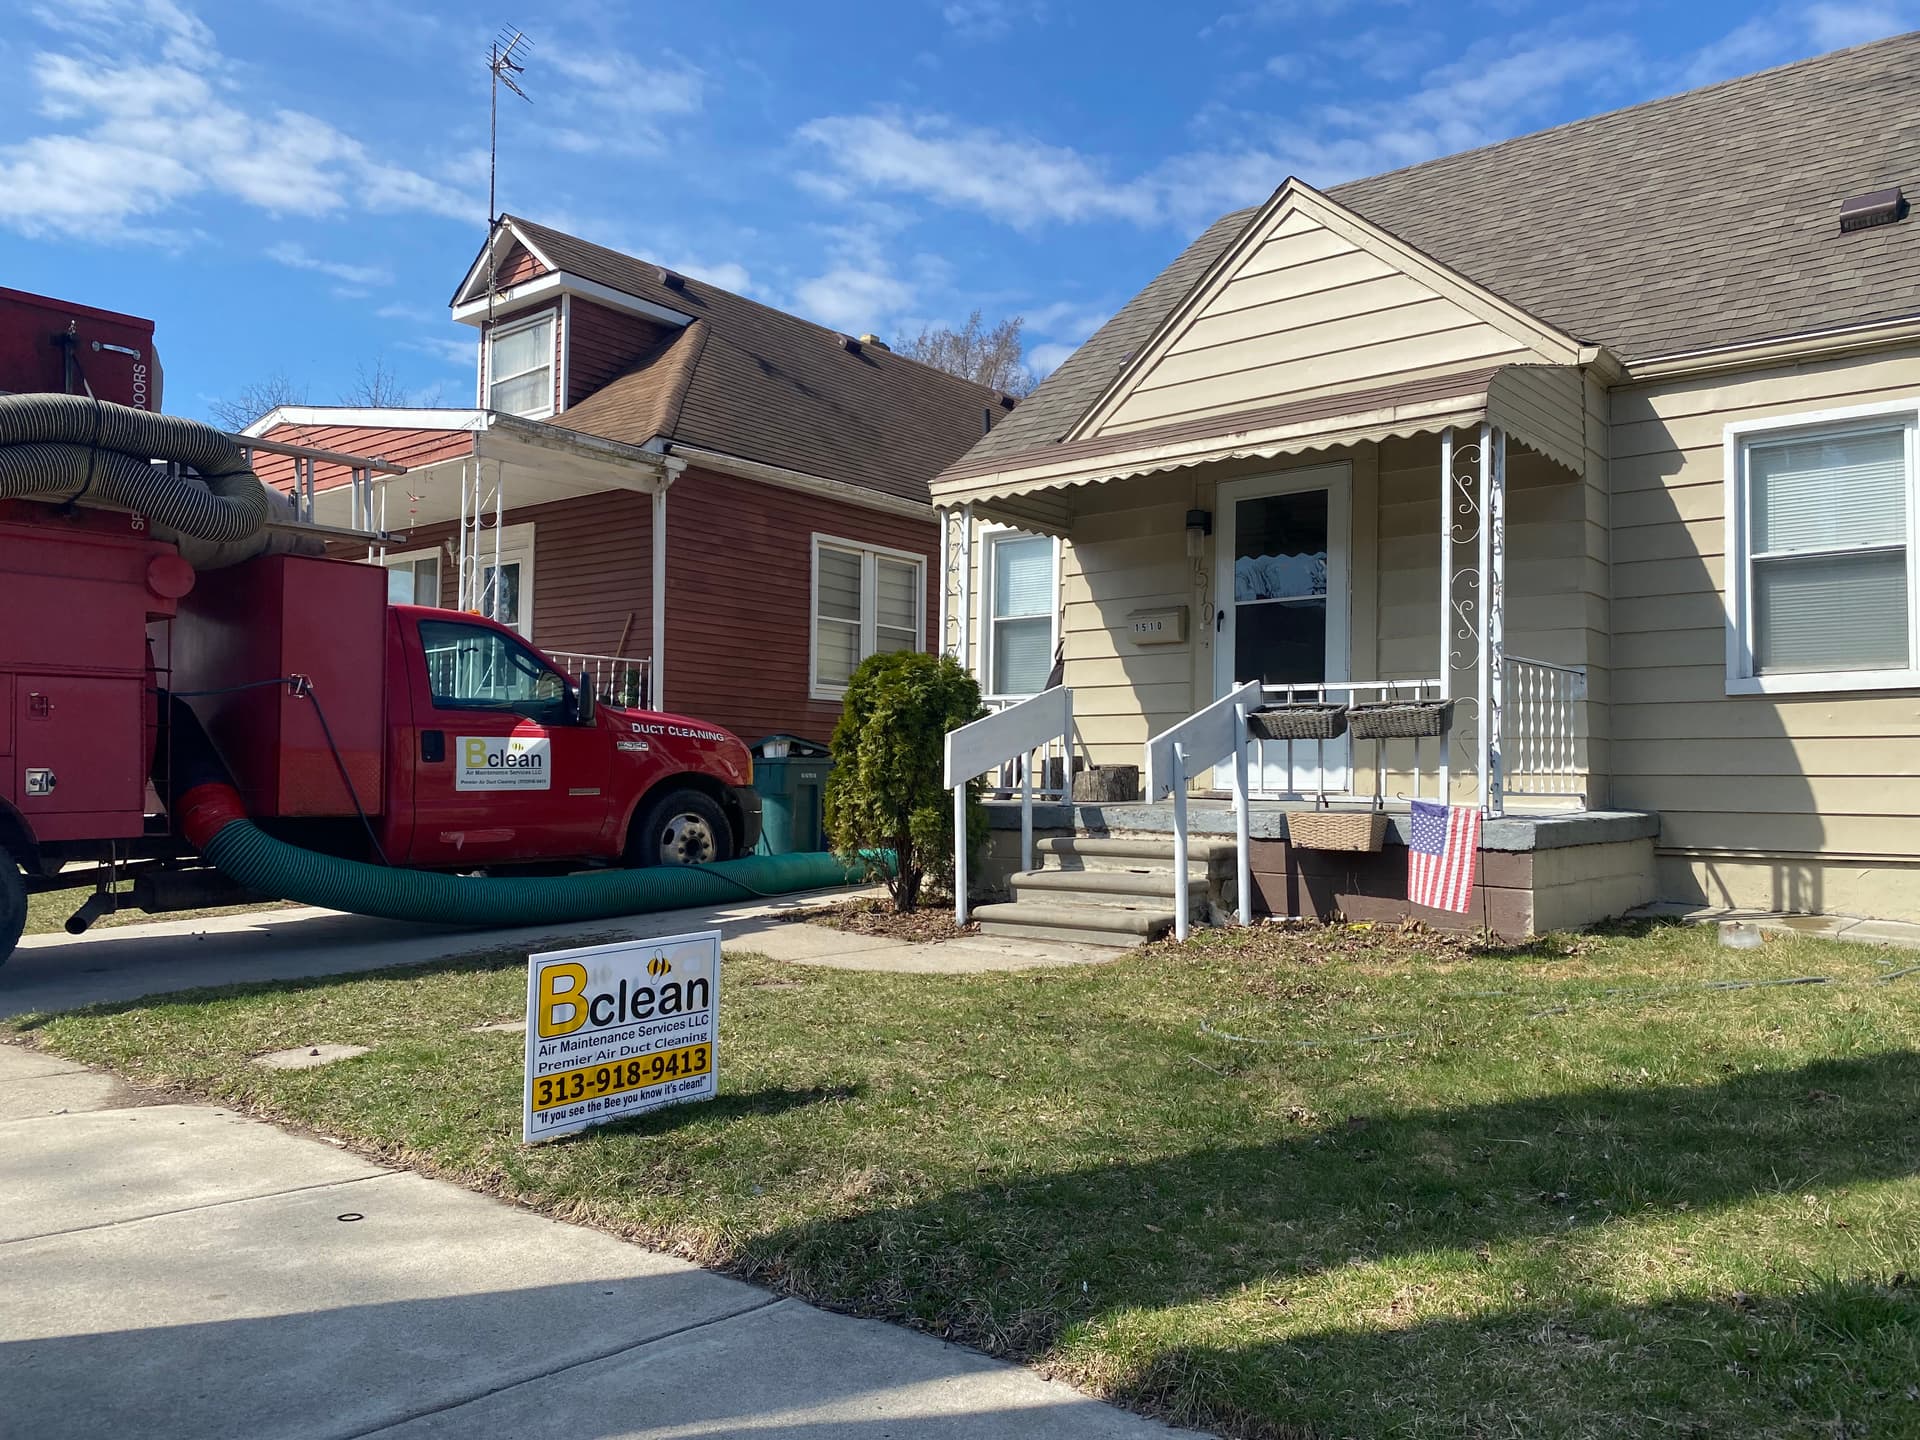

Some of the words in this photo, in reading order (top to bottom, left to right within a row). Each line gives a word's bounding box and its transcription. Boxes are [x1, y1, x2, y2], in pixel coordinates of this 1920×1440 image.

[1135, 621, 1162, 632] 1510
[465, 738, 542, 768] Bclean
[631, 722, 665, 735] DUCT
[667, 725, 725, 742] CLEANING
[538, 962, 709, 1038] Bclean
[539, 1043, 558, 1057] Air
[560, 1030, 635, 1053] Maintenance
[638, 1020, 686, 1037] Services
[688, 1014, 709, 1028] LLC
[539, 1055, 593, 1073] Premier
[596, 1049, 616, 1061] Air
[620, 1043, 651, 1056] Duct
[654, 1032, 708, 1048] Cleaning
[538, 1047, 707, 1106] 313-918-9413
[550, 1109, 567, 1124] you
[569, 1105, 585, 1118] see
[587, 1100, 602, 1113] the
[604, 1097, 621, 1109] Bee
[623, 1094, 639, 1107] you
[640, 1088, 663, 1101] know
[664, 1083, 677, 1095] it's
[678, 1075, 707, 1092] clean!"
